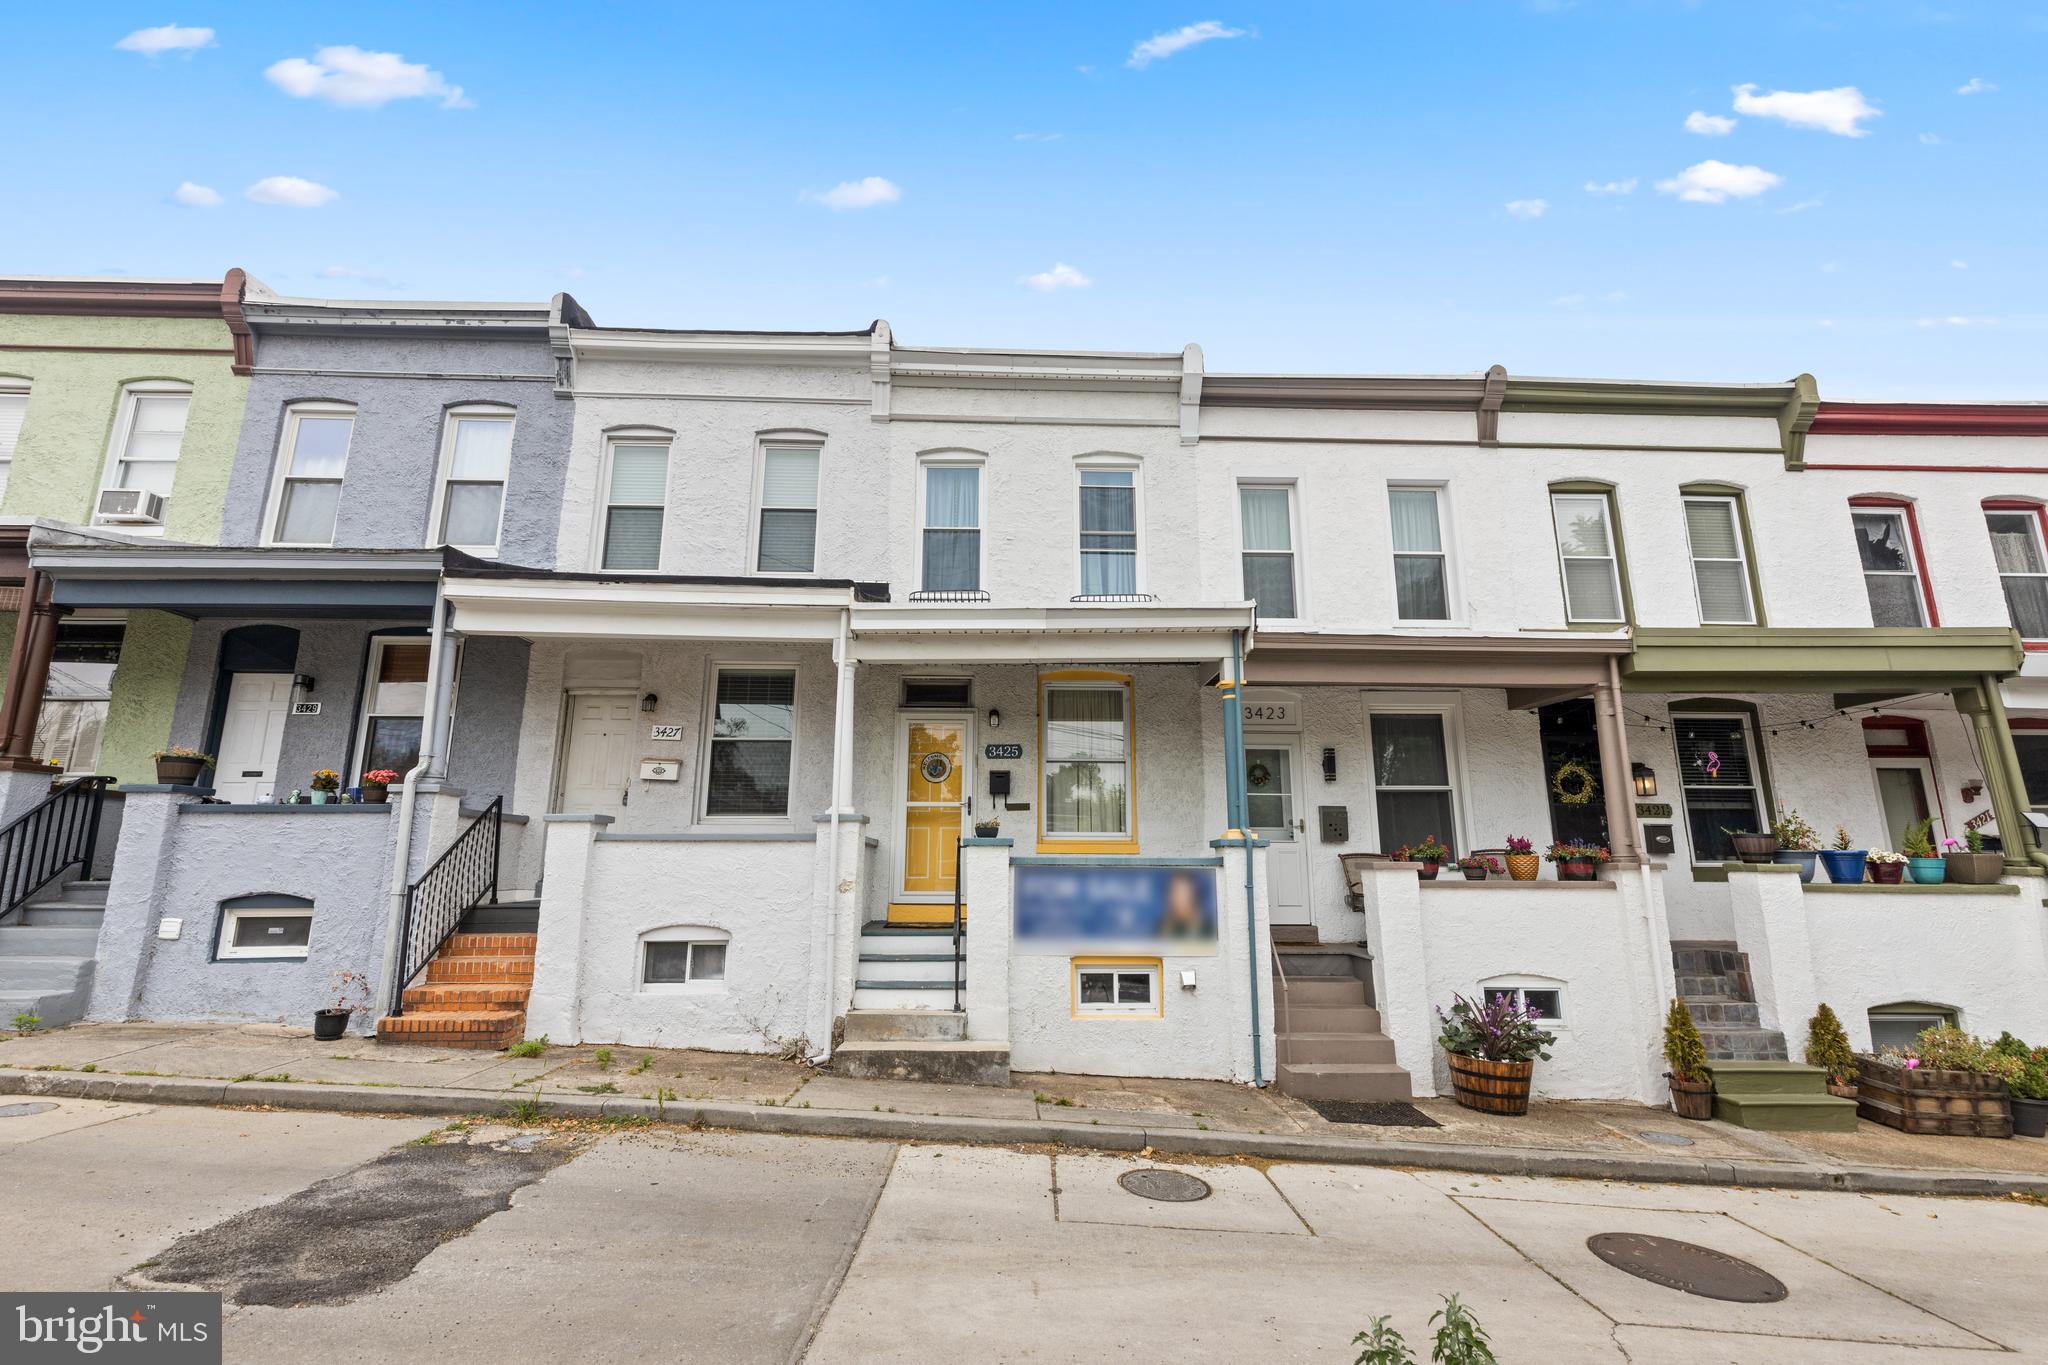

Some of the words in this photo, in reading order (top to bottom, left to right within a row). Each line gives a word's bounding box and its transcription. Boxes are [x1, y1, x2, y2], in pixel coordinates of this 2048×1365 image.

[296, 704, 318, 713] 3429
[1244, 706, 1285, 720] 3423
[653, 726, 681, 738] 3427
[988, 746, 1019, 757] 3425
